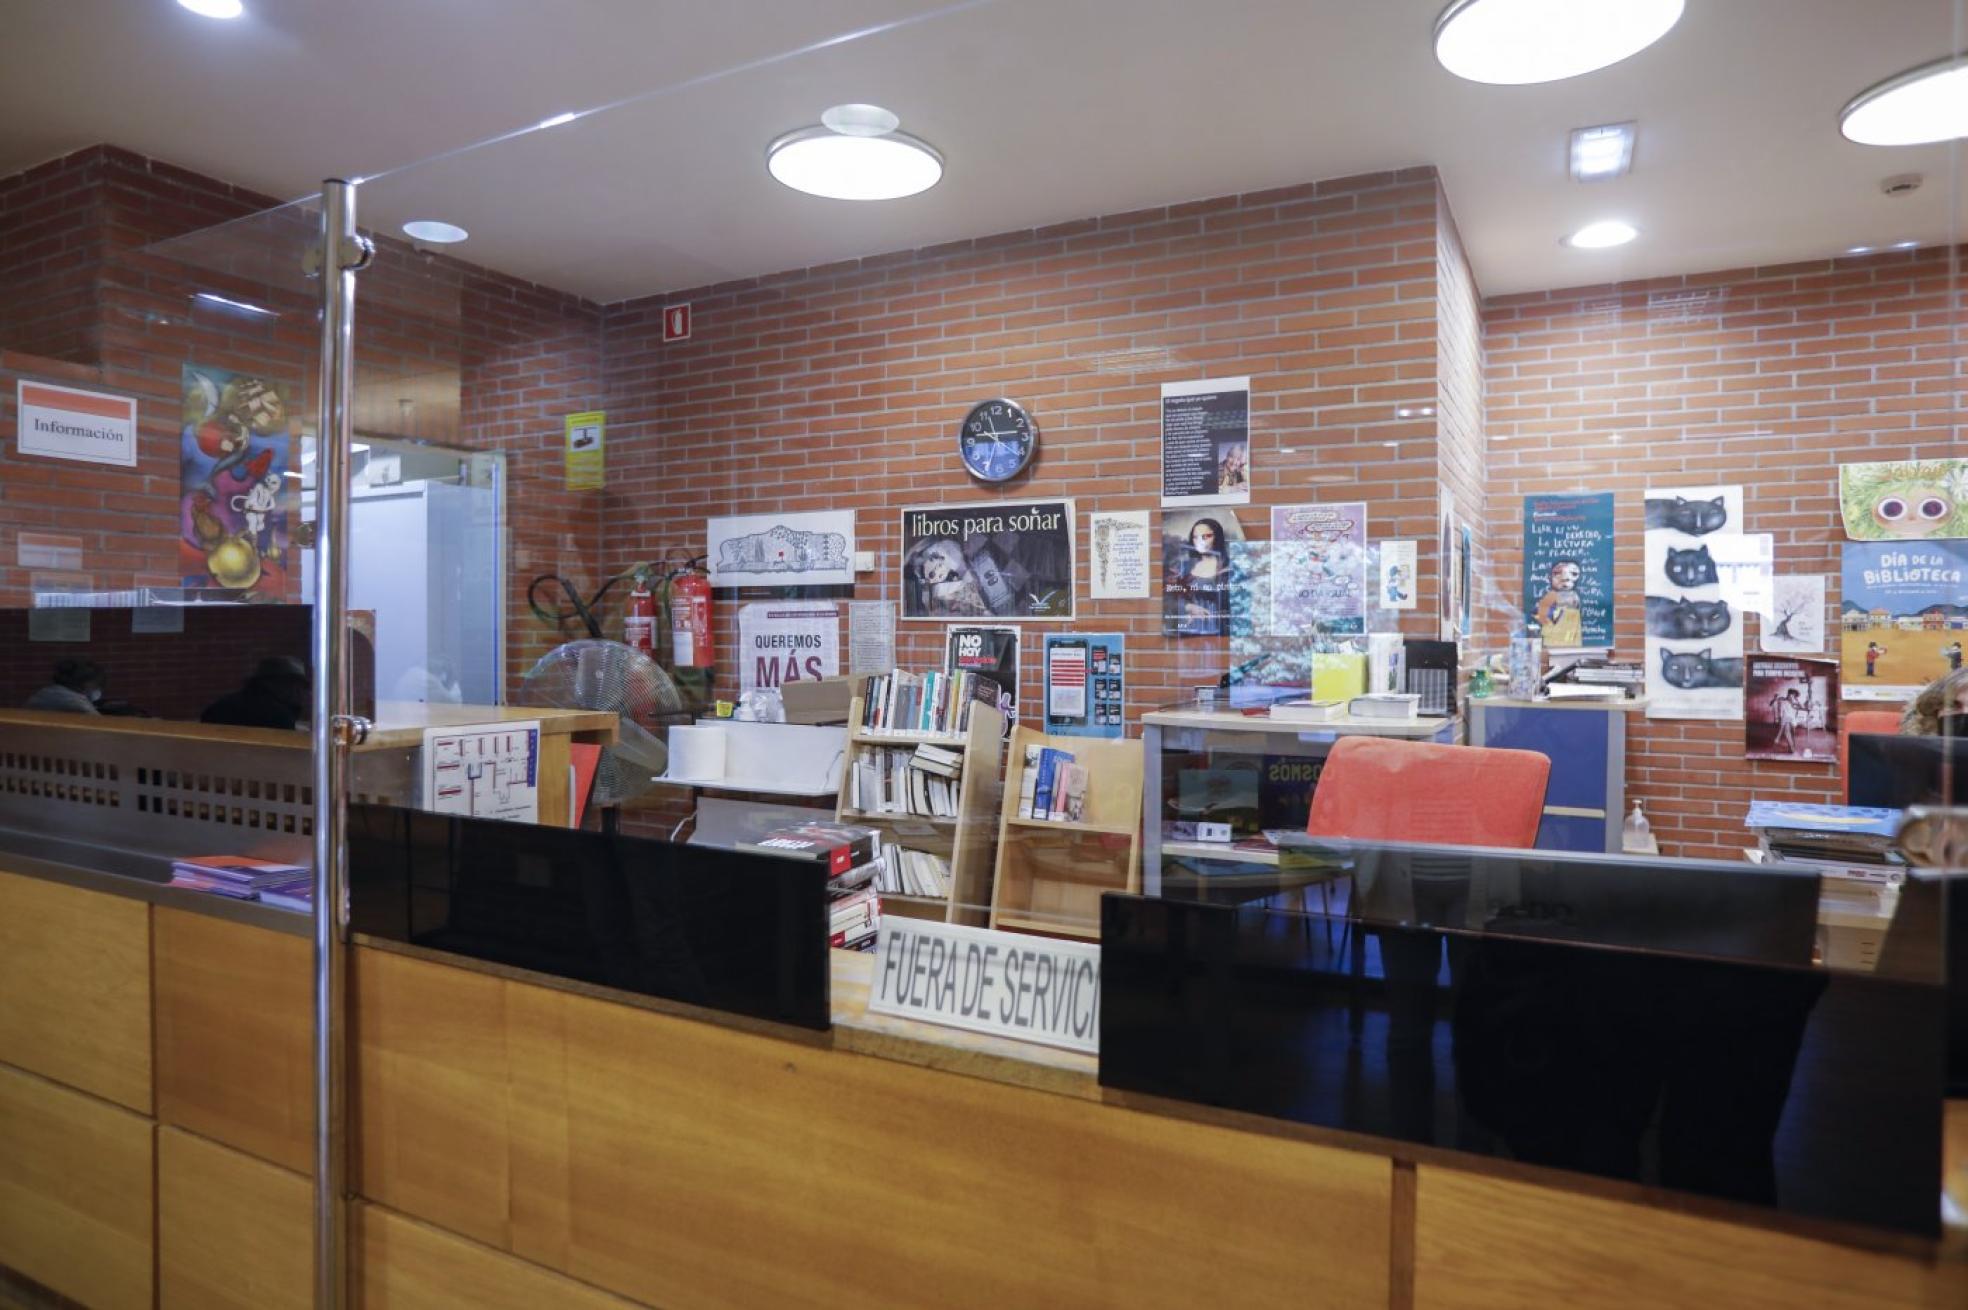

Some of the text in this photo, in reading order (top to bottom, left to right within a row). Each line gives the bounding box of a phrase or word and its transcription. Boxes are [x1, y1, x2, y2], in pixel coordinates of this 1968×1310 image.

[34, 418, 124, 442] Información
[970, 422, 982, 432] 10
[1016, 418, 1024, 428] 2
[1021, 432, 1029, 442] 3
[912, 507, 1061, 542] libros para soñar
[1880, 552, 1944, 568] DÍA DE LA
[1863, 568, 1961, 585] BIBLIOTECA
[755, 634, 822, 649] QUEREMOS
[959, 634, 982, 648] NO
[755, 648, 823, 688] MÁS
[881, 931, 1101, 1039] FUERA DE SERVICI
